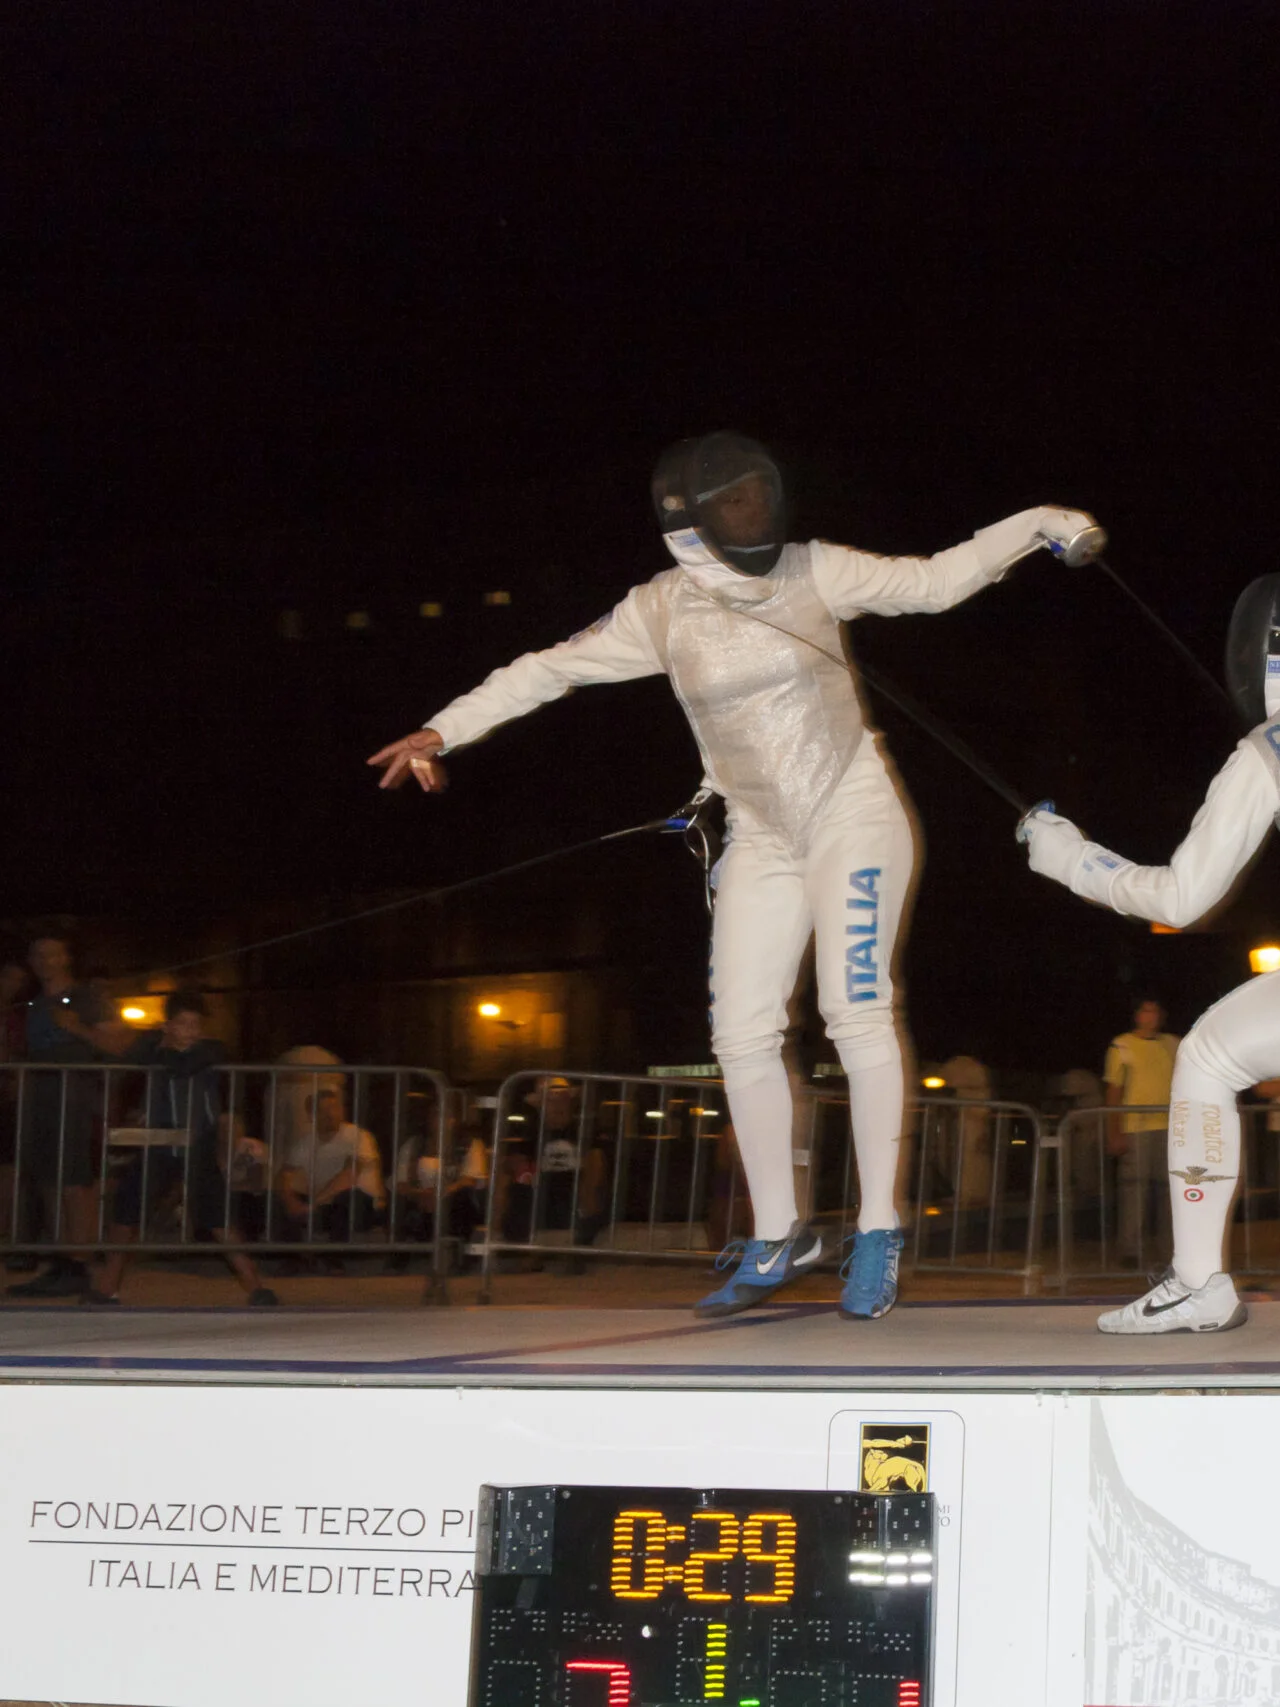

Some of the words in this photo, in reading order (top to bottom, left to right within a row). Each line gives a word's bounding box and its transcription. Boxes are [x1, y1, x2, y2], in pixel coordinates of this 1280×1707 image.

[845, 867, 882, 1004] ITALIA
[30, 1500, 283, 1534] FONDAZIONE
[294, 1506, 426, 1537] TERZO
[440, 1508, 475, 1538] PI
[88, 1559, 202, 1591] ITALIA
[214, 1562, 238, 1592] E
[249, 1564, 478, 1599] MEDITERRA
[610, 1511, 797, 1602] 0:29
